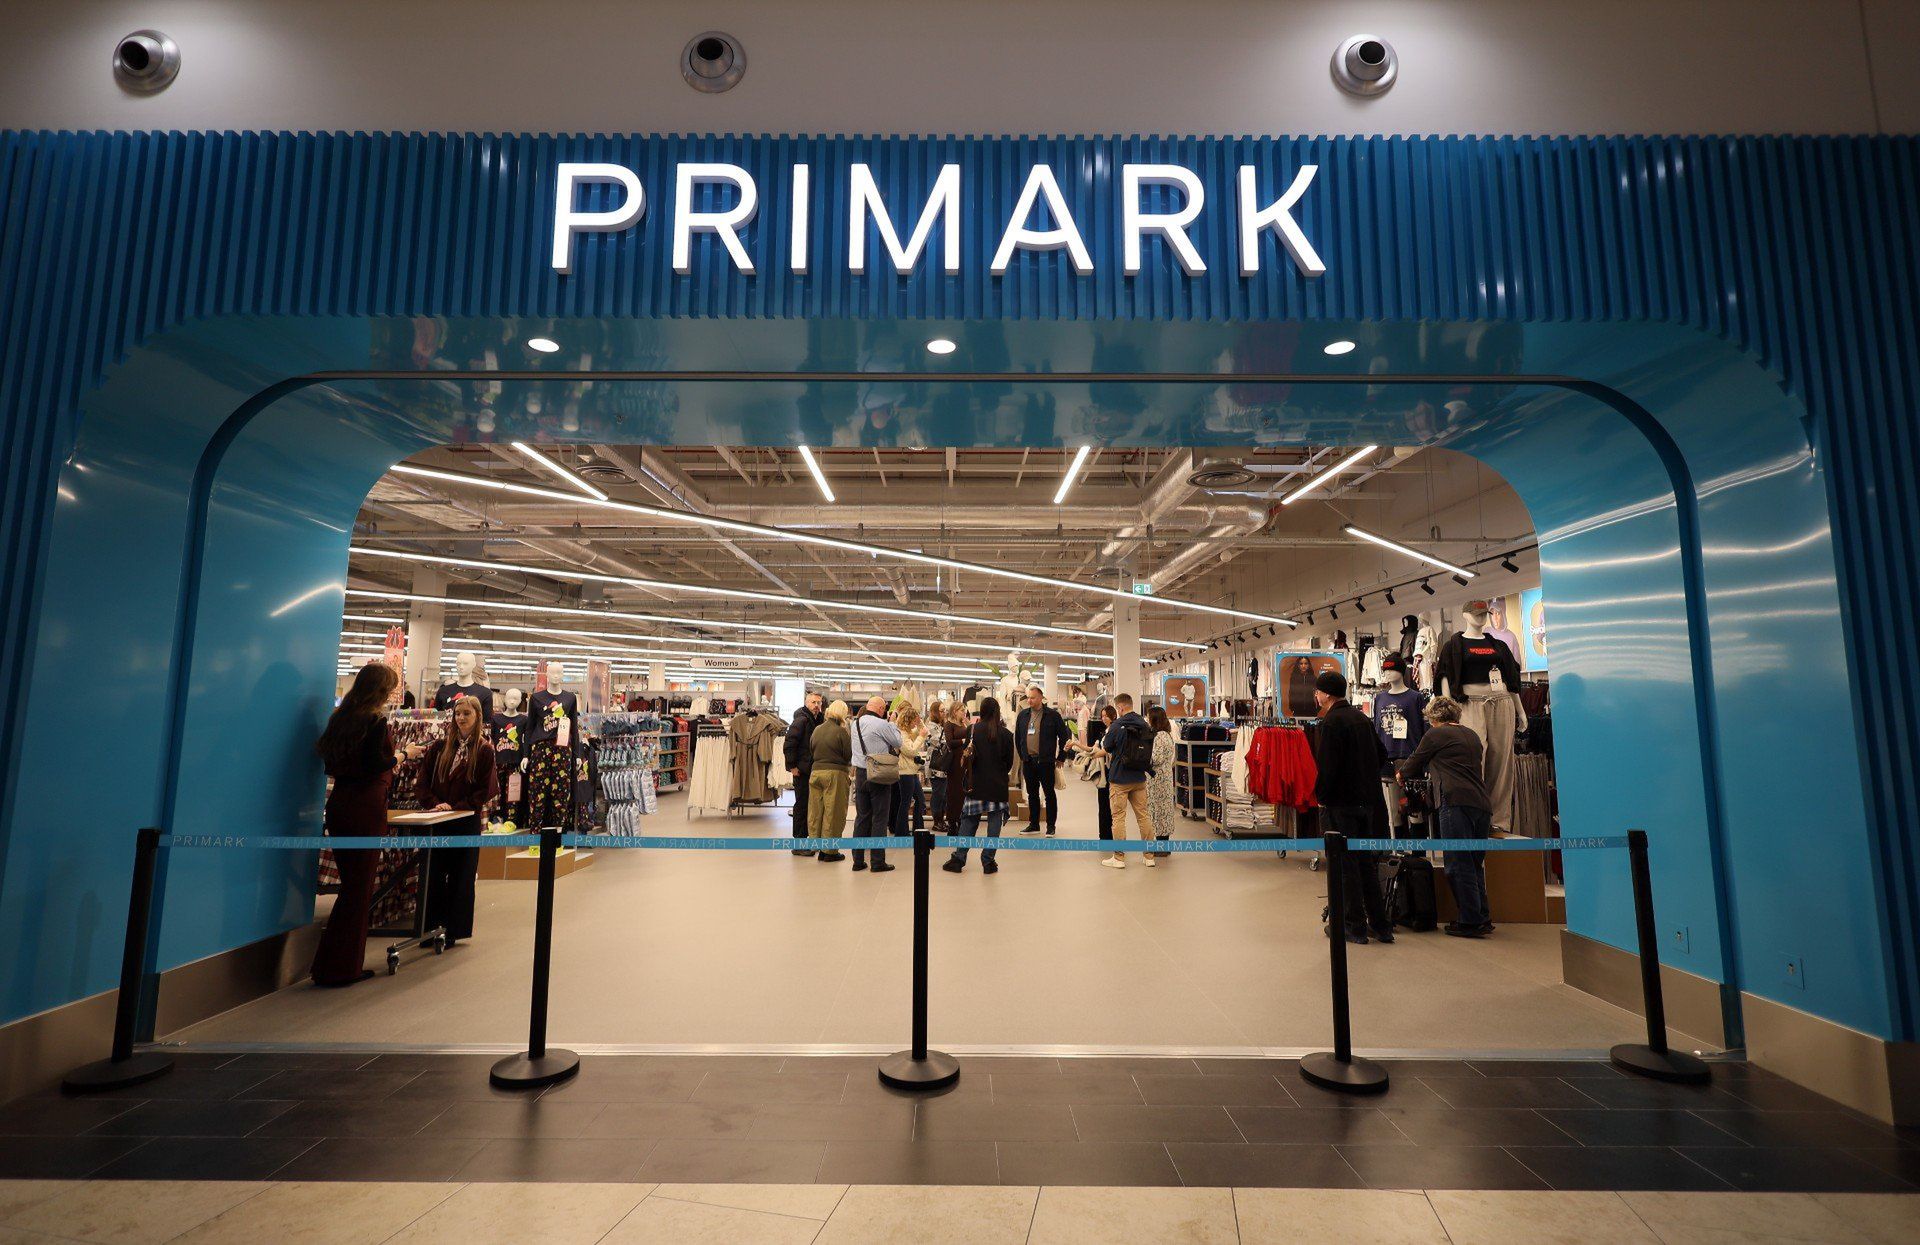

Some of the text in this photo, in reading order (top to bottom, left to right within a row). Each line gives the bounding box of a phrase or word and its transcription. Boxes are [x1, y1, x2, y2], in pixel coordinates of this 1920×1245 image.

[551, 163, 1326, 278] PRIMARK
[704, 659, 739, 667] Womens
[172, 835, 246, 847] PRIMARK
[380, 837, 451, 847] PRIMARK
[574, 837, 644, 847] PRIMARK
[772, 838, 842, 849] PRIMARK
[948, 837, 1019, 849] PRIMARK
[1146, 841, 1215, 851] PRIMARK
[1360, 840, 1426, 850] PRIMARK
[1544, 838, 1608, 848] PRIMARK
